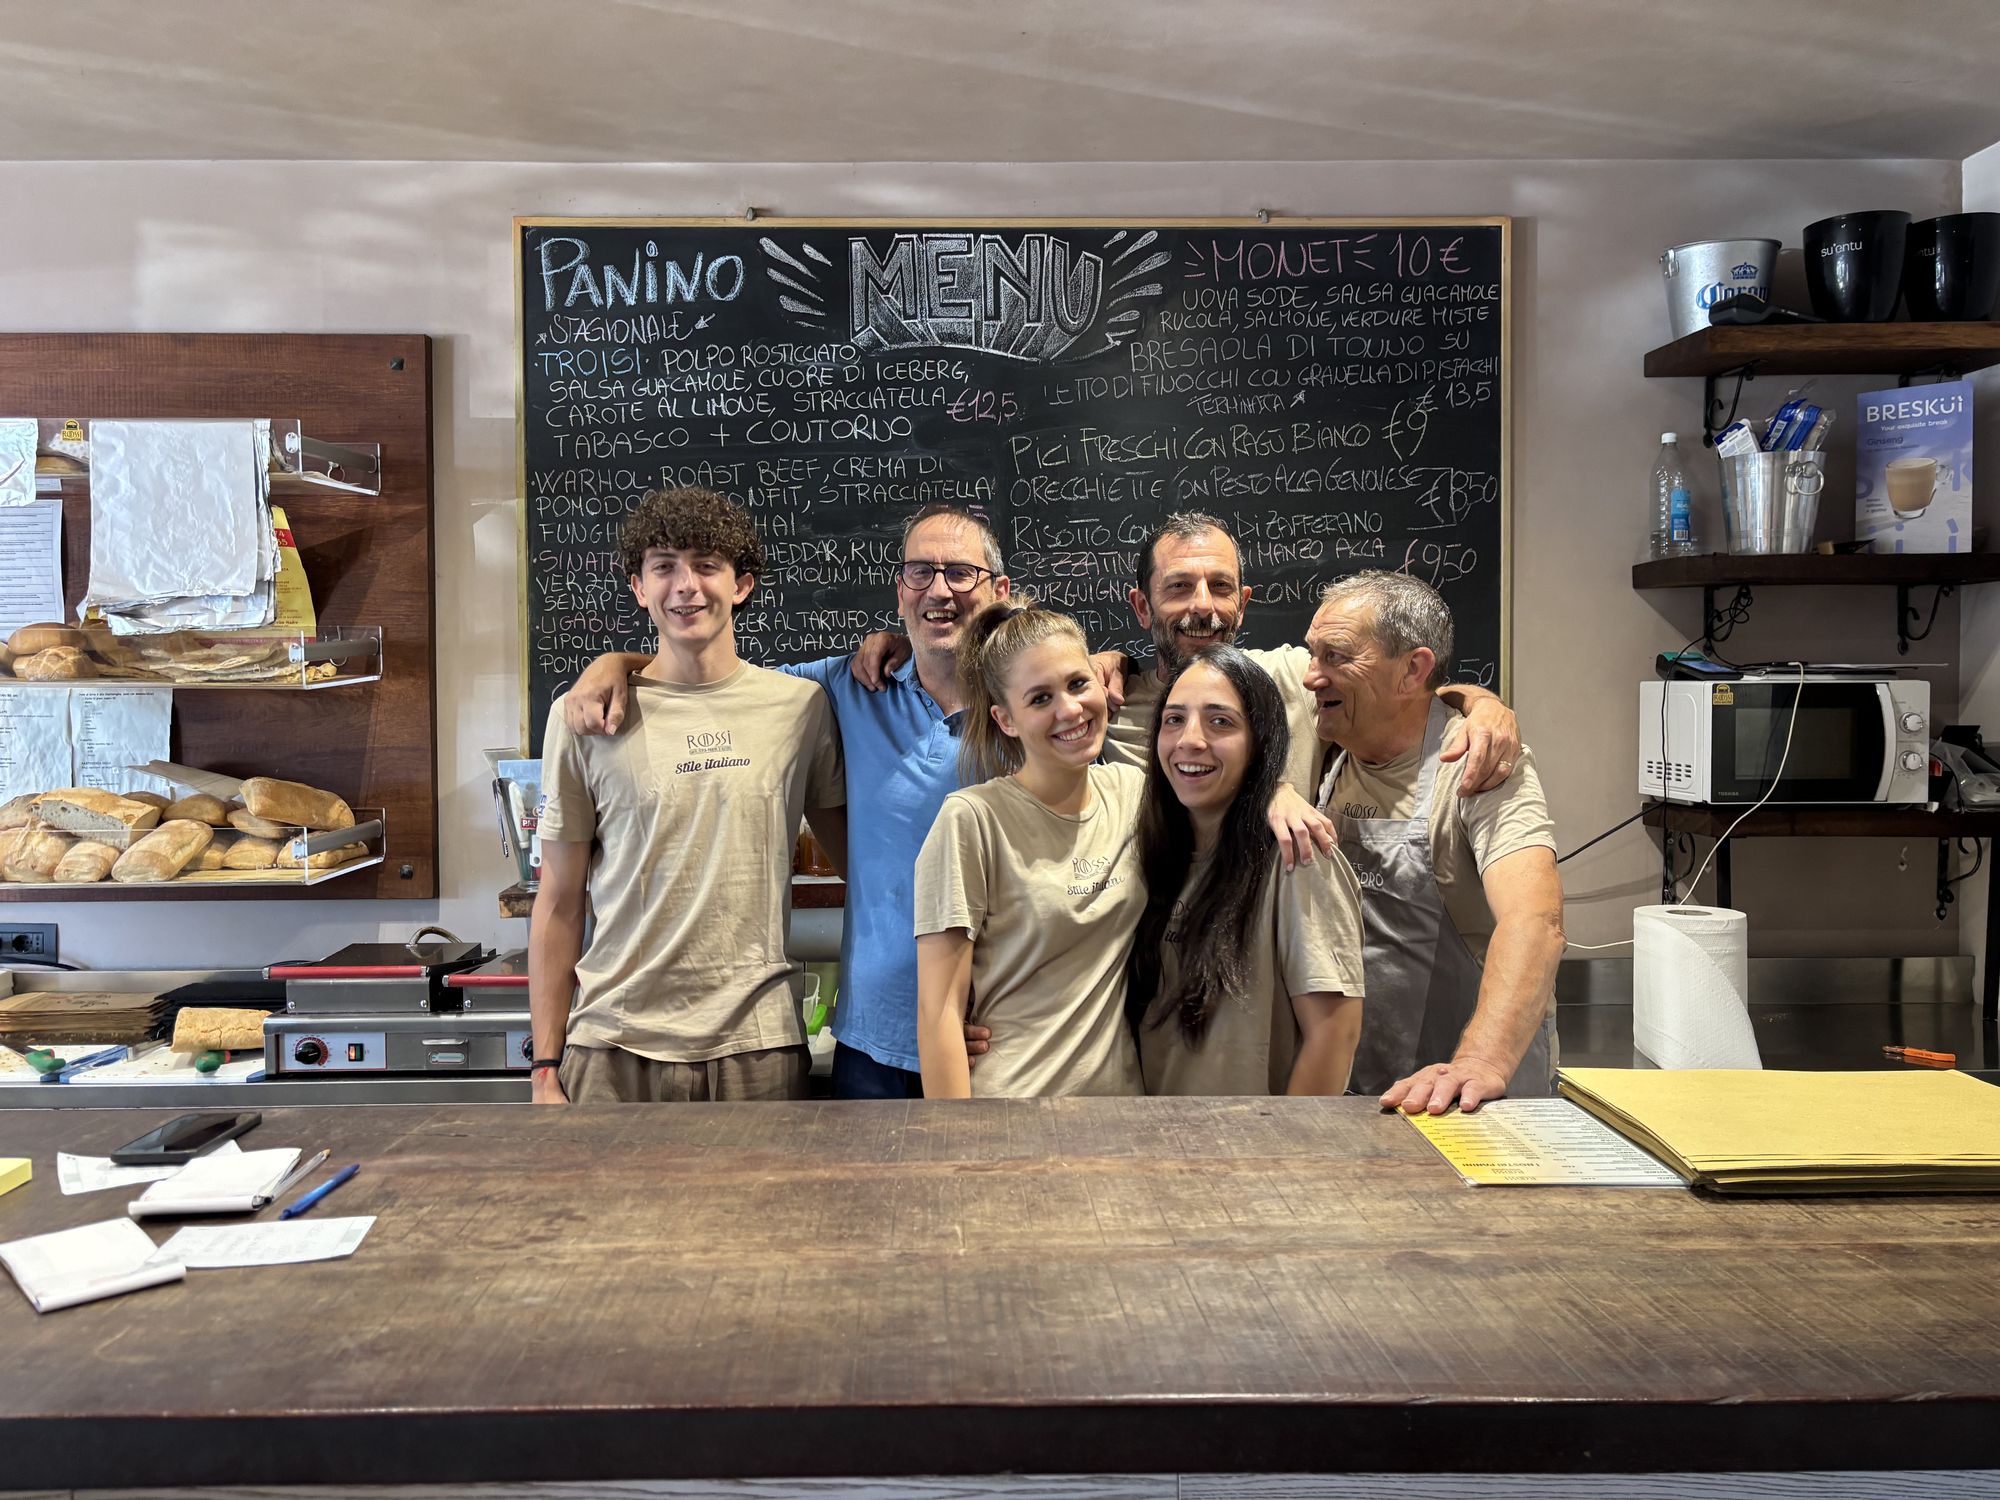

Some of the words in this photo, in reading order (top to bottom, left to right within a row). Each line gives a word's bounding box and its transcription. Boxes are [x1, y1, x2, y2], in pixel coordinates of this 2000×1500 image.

[1212, 239, 1350, 281] MONET
[1389, 233, 1431, 278] 10
[848, 232, 1103, 358] MENU
[1183, 287, 1239, 311] UOVA
[1323, 283, 1394, 307] SALSA
[1400, 284, 1500, 305] GUACAMOLE
[550, 311, 694, 345] STAGIONALE
[1341, 308, 1426, 328] VERDURE
[1432, 306, 1491, 327] MISTE
[661, 345, 736, 376] POLPO
[1130, 333, 1271, 373] BRESAOLA
[1286, 334, 1316, 361] DI
[1326, 335, 1425, 359] TONNO
[1439, 330, 1471, 350] SU
[550, 379, 625, 403] SALSA
[758, 364, 834, 389] CUORE
[843, 363, 866, 382] DI
[1113, 375, 1134, 399] DI
[1140, 368, 1239, 397] FINOCCHI
[1247, 367, 1292, 388] CON
[1298, 363, 1392, 388] GRANELLA
[1396, 361, 1418, 384] DI
[1422, 356, 1500, 381] PISTACCHI
[546, 402, 646, 428] CAROTE
[658, 398, 685, 418] AL
[794, 386, 946, 412] STRACCIATELLA
[1446, 381, 1493, 409] 13,5
[553, 427, 690, 460] TABASCO
[746, 414, 912, 445] CONTORNO
[1080, 427, 1178, 467] FRESCHI
[1184, 427, 1227, 460] CON
[660, 460, 746, 488] ROAST
[833, 457, 907, 479] CREMA
[919, 457, 944, 475] DI
[1210, 465, 1272, 498] PESTO
[1275, 464, 1322, 494] ALLA
[1325, 457, 1423, 493] GENOVESE
[536, 489, 657, 519] POMODO
[714, 484, 811, 514] ONFIT,
[754, 511, 796, 537] HAI
[1234, 510, 1261, 539] DI
[1266, 510, 1383, 540] ZAFFERANO
[540, 549, 625, 573] SINATR
[761, 538, 847, 568] HEDDAR,
[1256, 537, 1324, 567] MANZO
[1336, 537, 1386, 559] ALLA
[536, 571, 618, 595] VERZA
[752, 589, 784, 608] HAI
[1010, 576, 1139, 607] BOURGUIGNO
[775, 611, 799, 632] AL
[1108, 607, 1131, 631] DI
[537, 633, 615, 653] CIPOLLA
[539, 654, 598, 675] POMO
[704, 757, 750, 770] italiano
[1358, 871, 1384, 887] DRO
